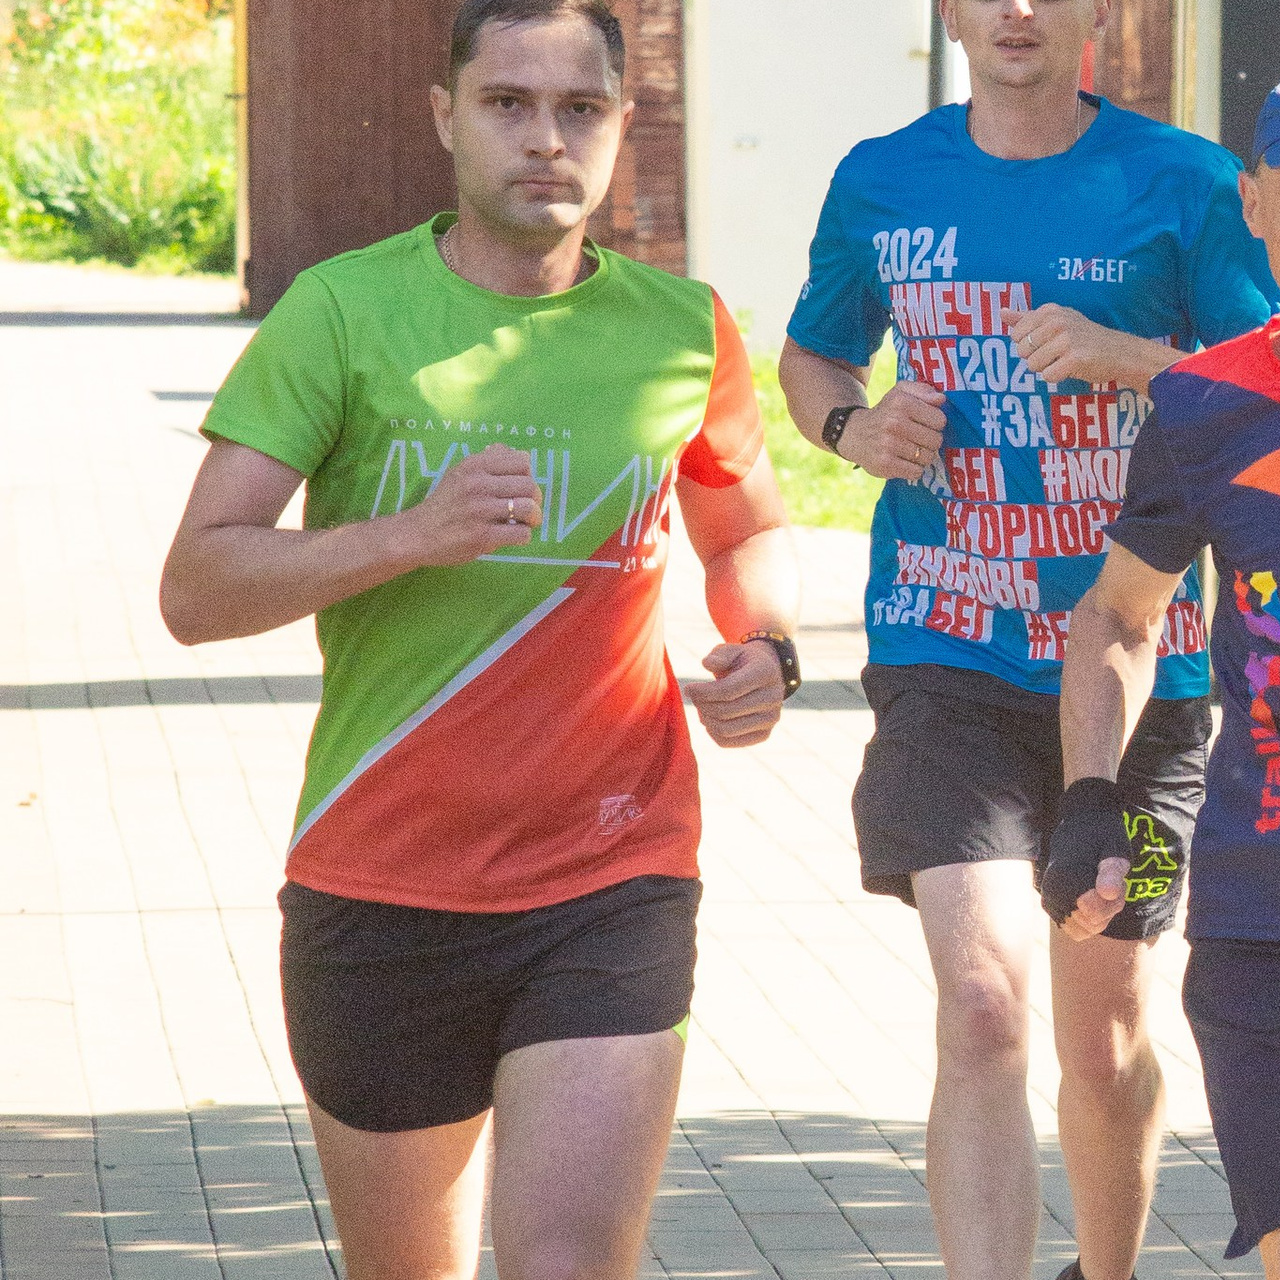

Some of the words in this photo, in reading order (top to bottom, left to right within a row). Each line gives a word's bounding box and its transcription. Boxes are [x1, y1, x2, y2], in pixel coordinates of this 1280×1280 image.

[873, 226, 959, 282] 2024
[891, 282, 1031, 336] #МЕЧТА
[390, 419, 572, 439] ПОЛУМАРАФОН
